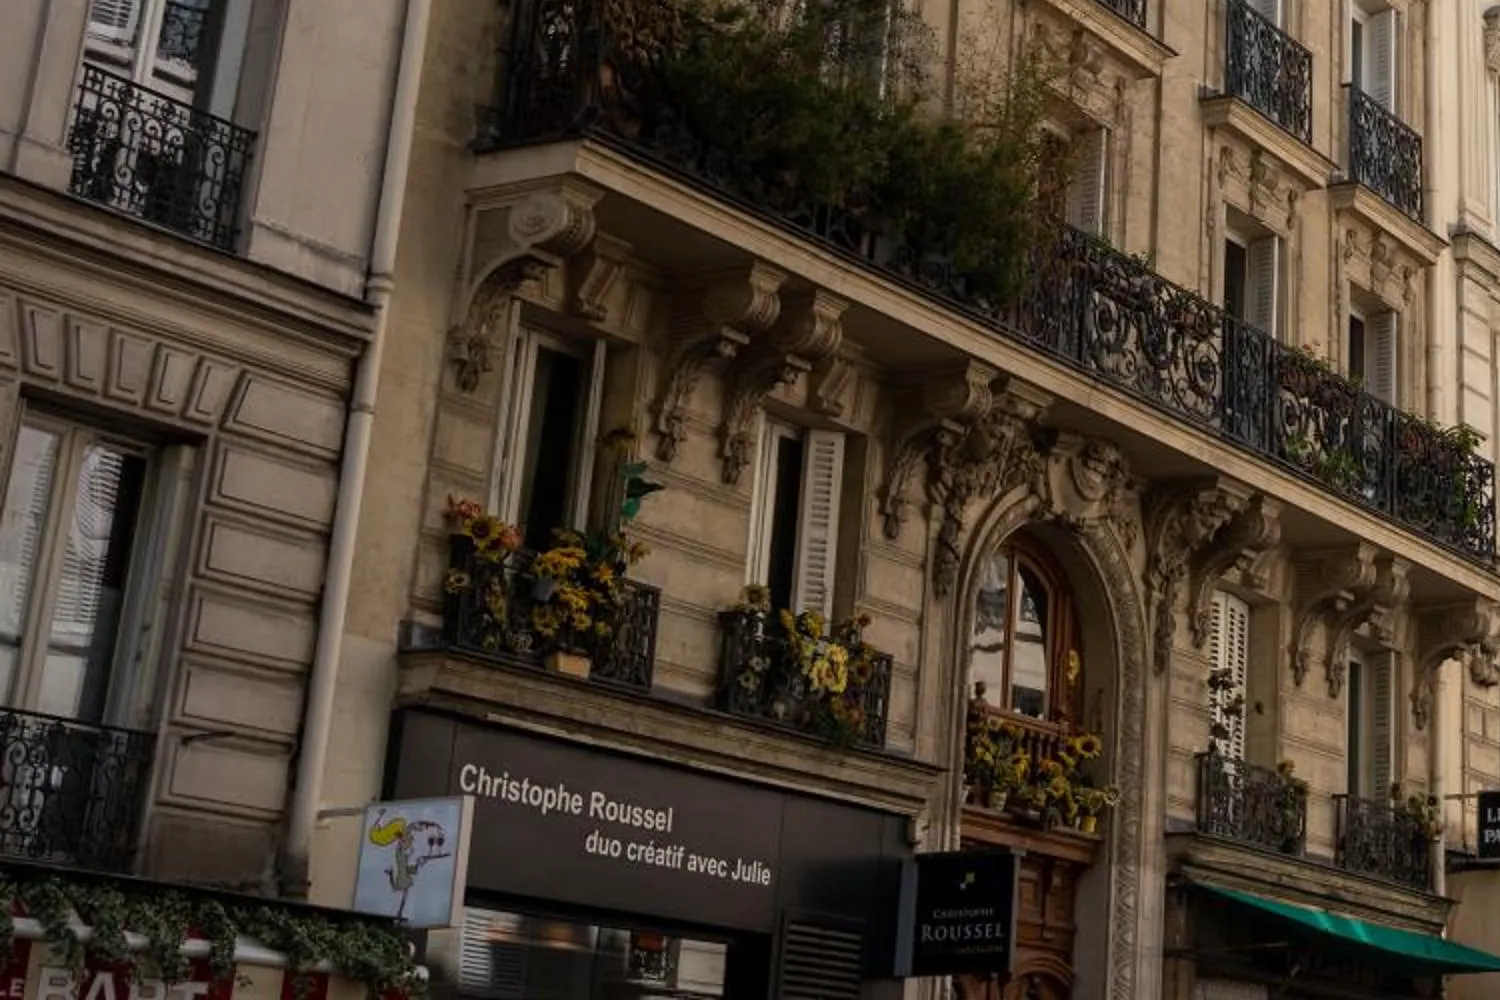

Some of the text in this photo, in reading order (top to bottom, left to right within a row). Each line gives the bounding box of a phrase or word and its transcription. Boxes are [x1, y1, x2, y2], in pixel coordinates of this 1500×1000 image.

[460, 764, 674, 833] Christophe Roussel
[585, 830, 771, 886] duo créatif avec Julie
[921, 921, 1005, 942] ROUSSEL
